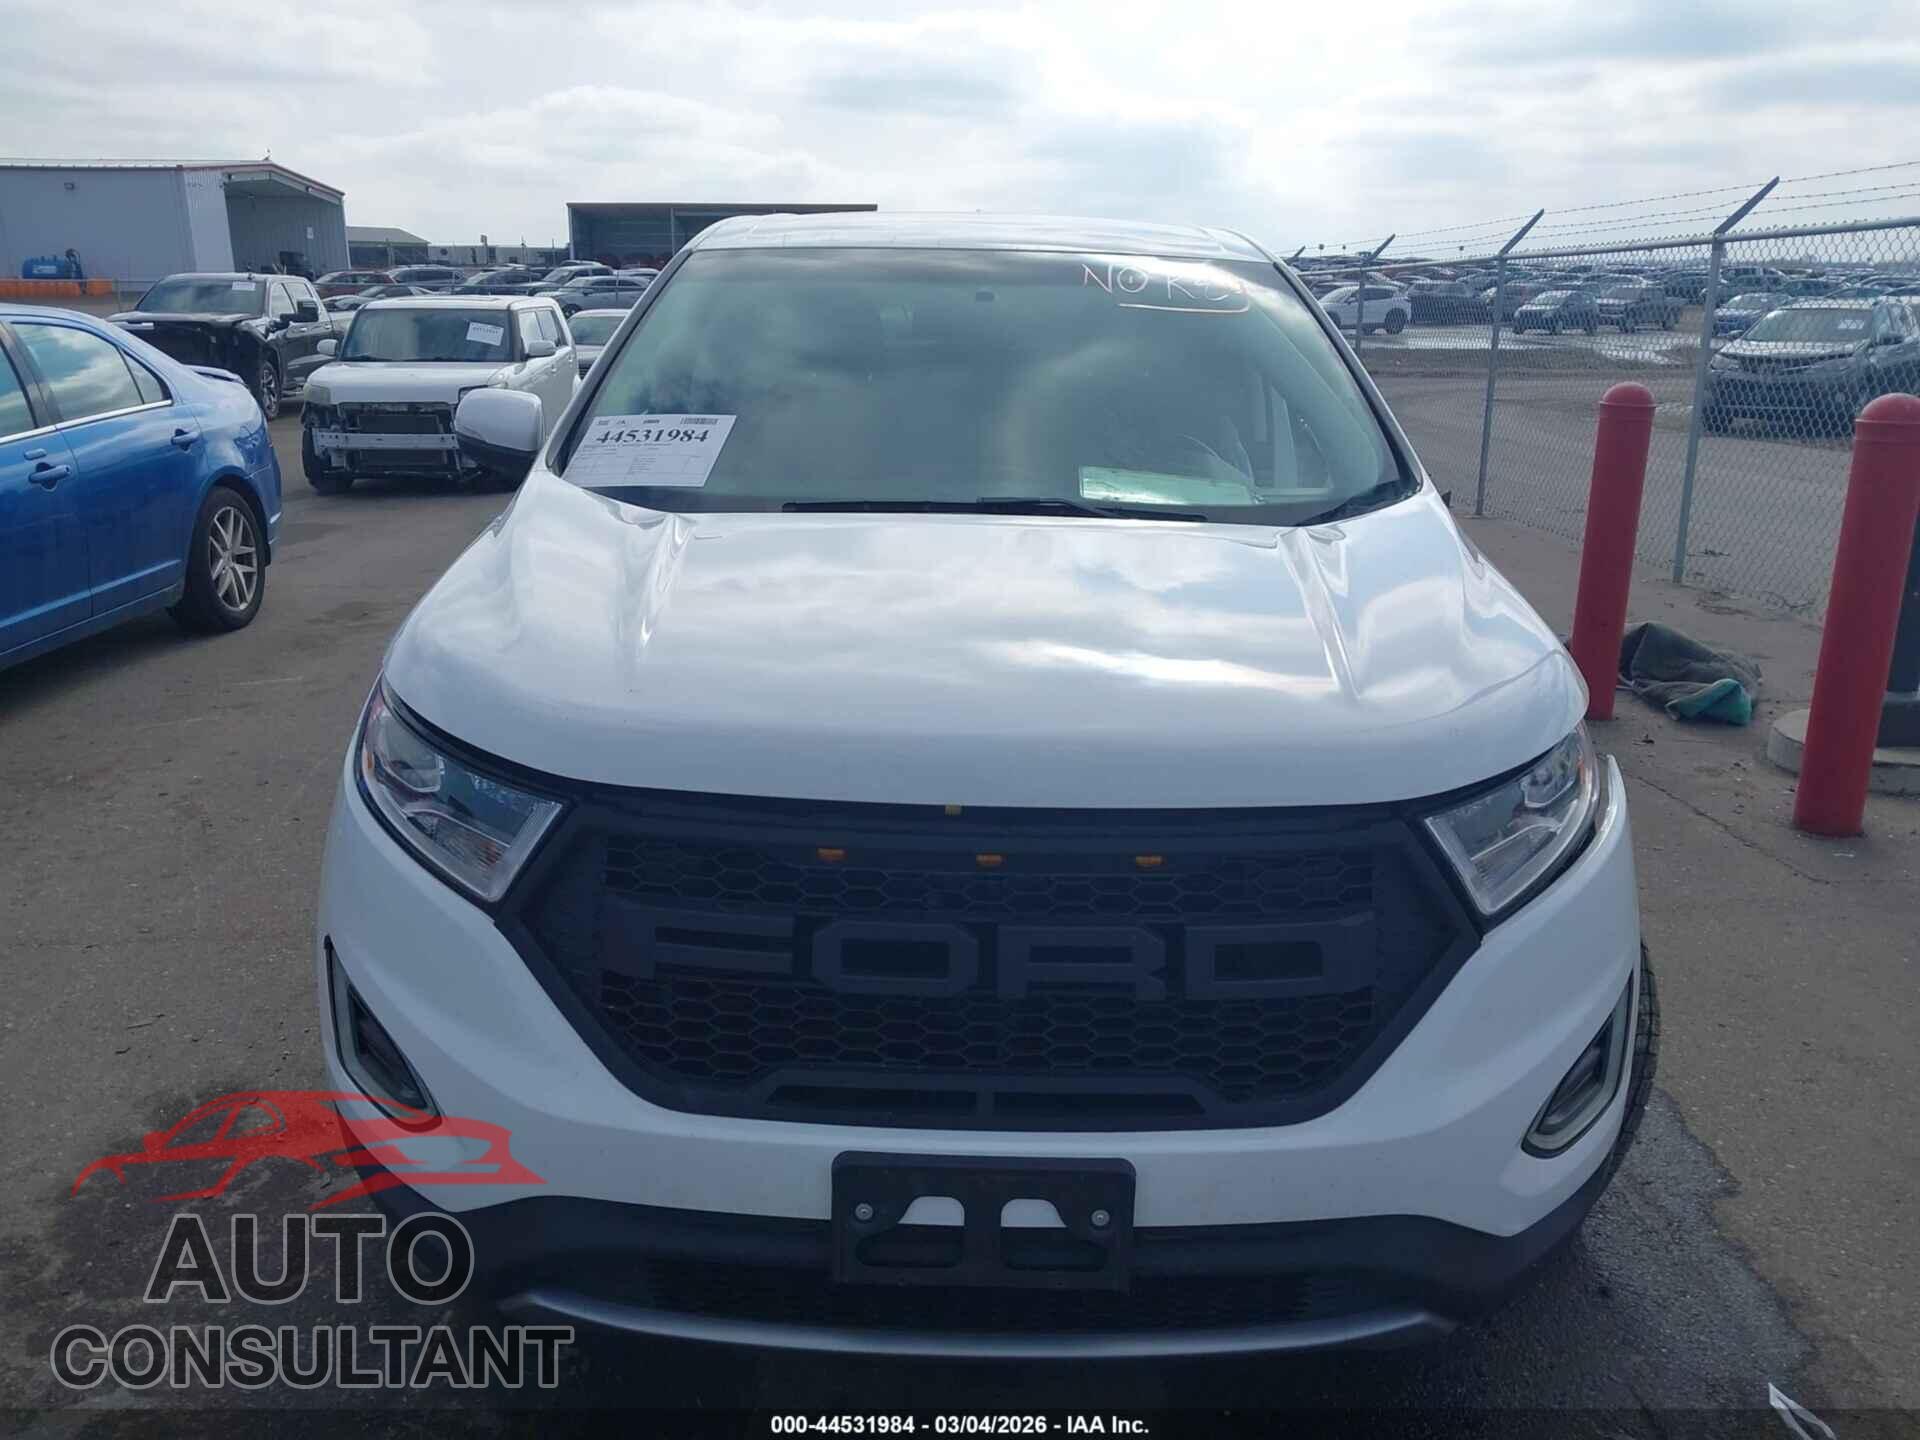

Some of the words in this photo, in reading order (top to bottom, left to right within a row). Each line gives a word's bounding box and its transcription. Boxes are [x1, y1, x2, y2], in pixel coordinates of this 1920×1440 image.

[1081, 262, 1150, 294] NO
[595, 428, 710, 444] 44531984
[602, 897, 1374, 1001] FORD
